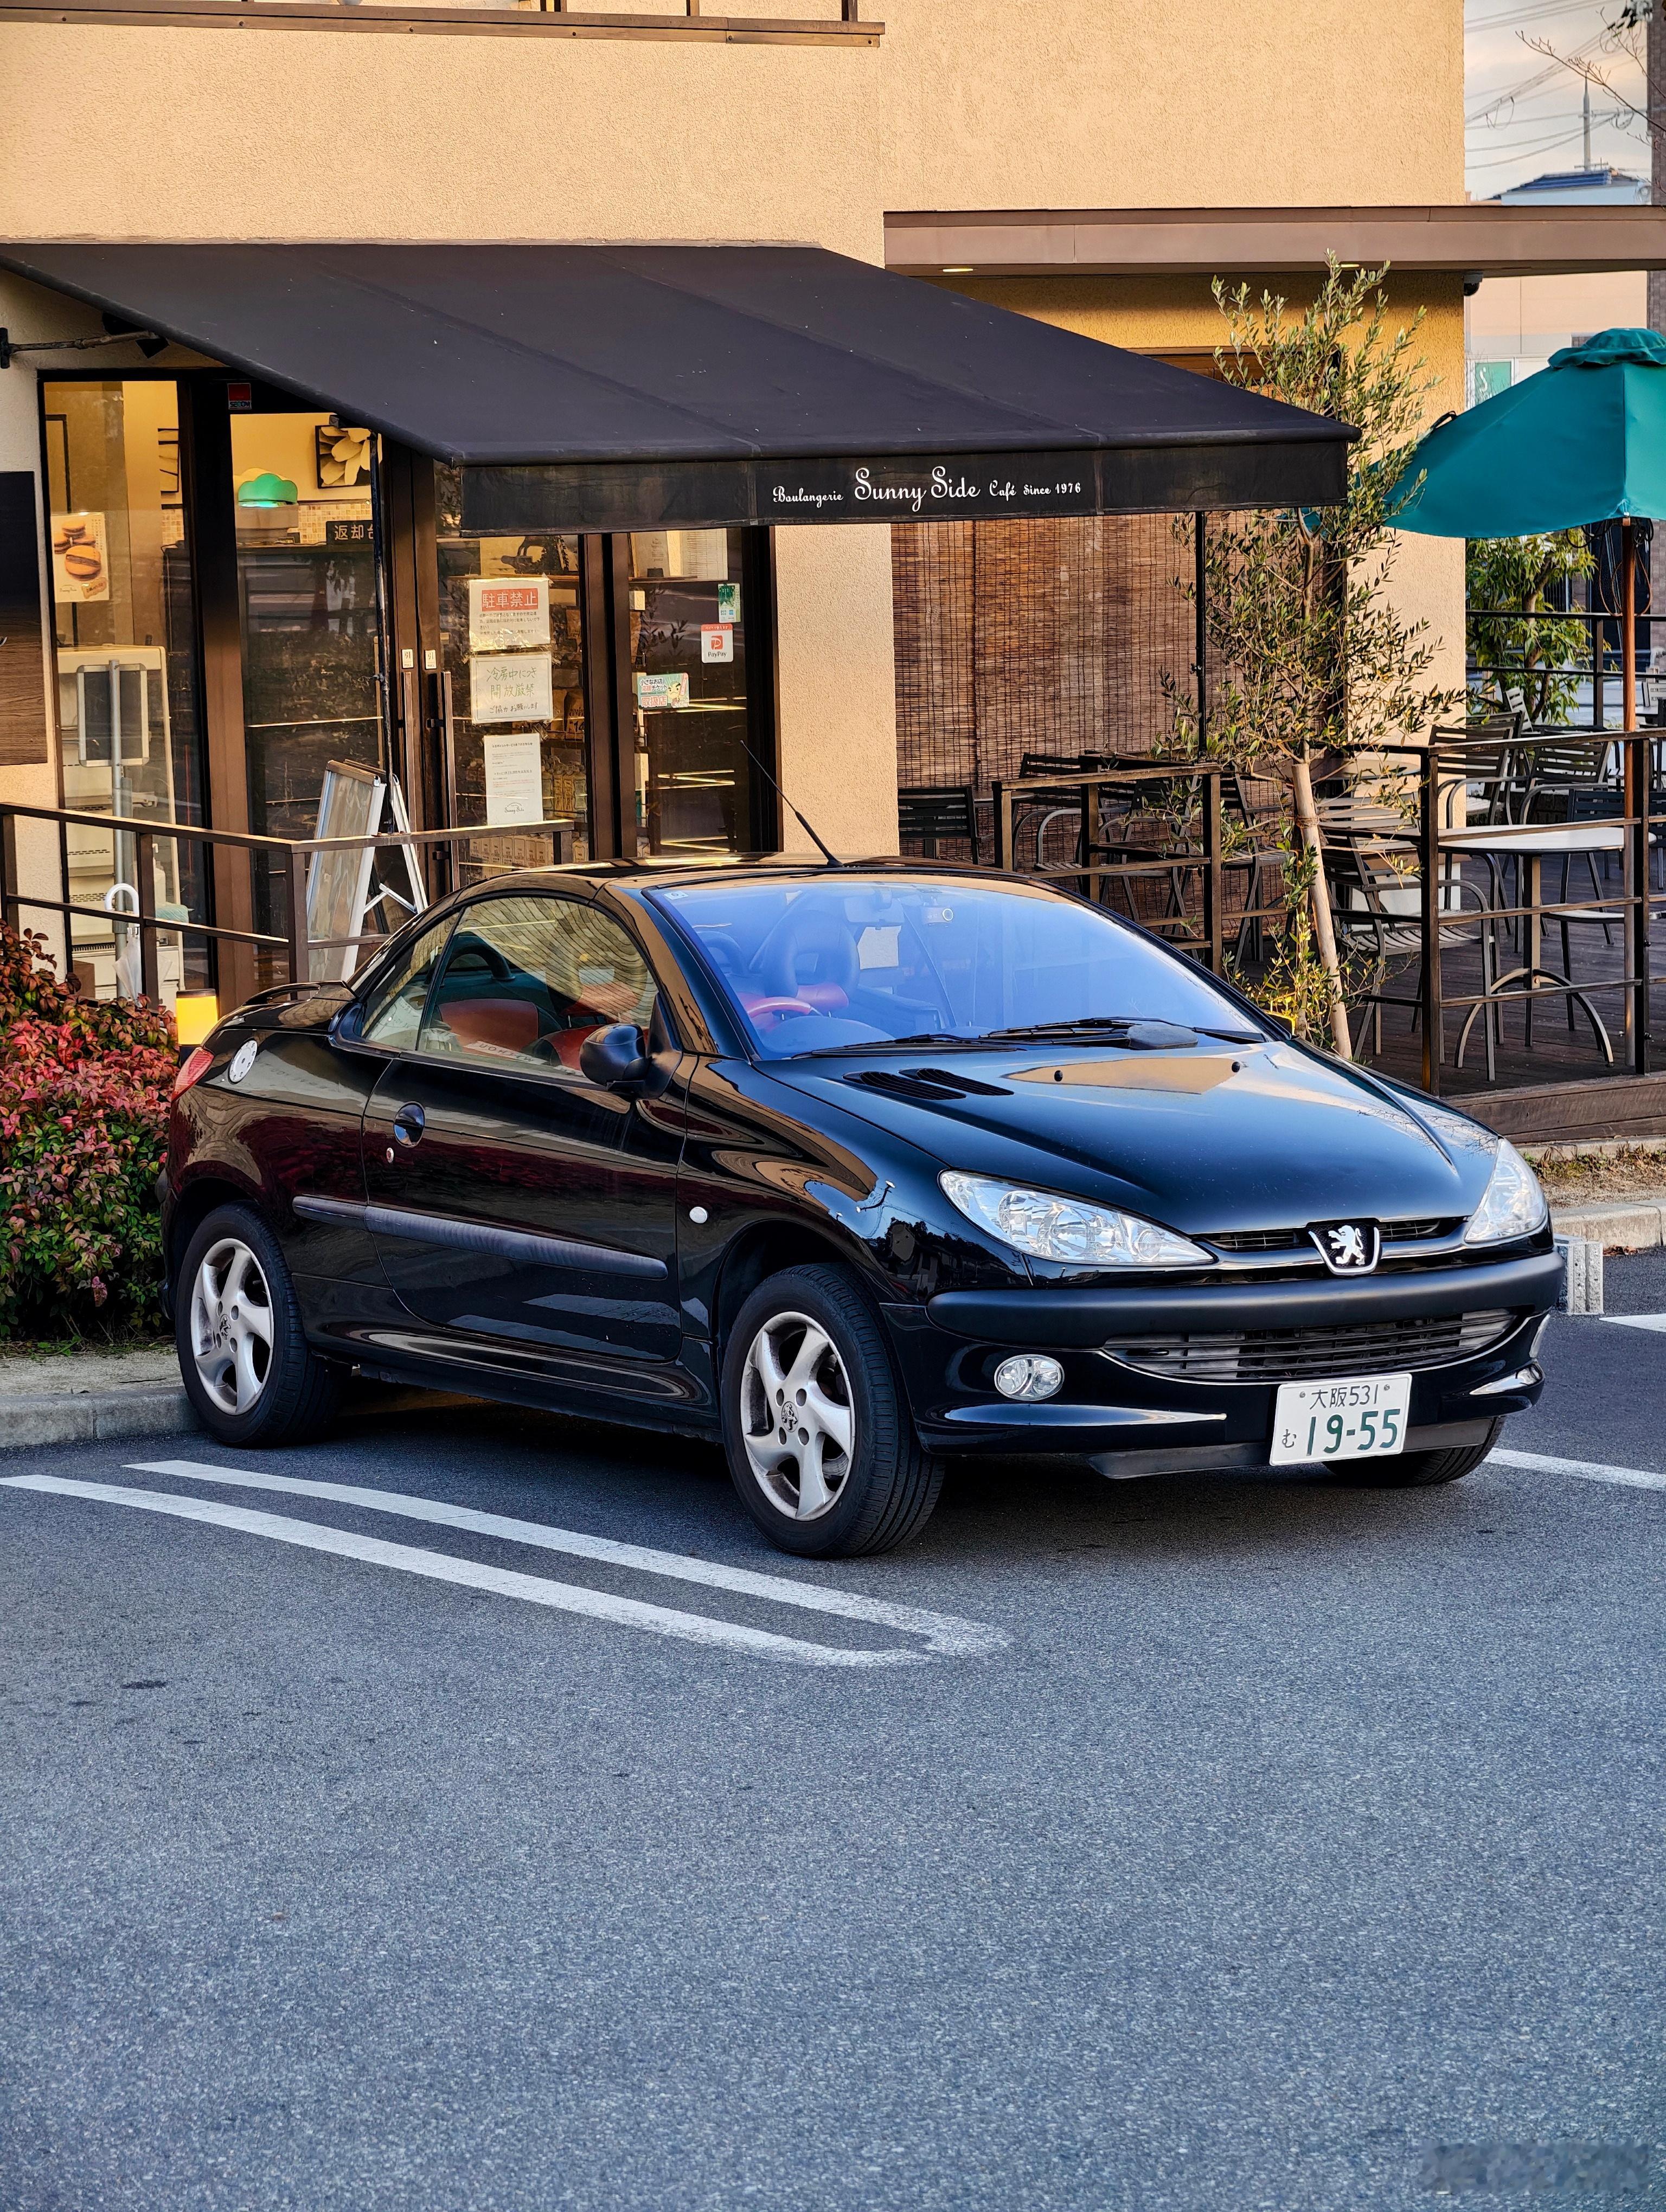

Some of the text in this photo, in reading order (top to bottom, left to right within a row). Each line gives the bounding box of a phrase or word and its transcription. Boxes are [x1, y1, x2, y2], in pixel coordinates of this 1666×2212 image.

[773, 486, 844, 508] Boulangerie
[855, 467, 927, 512] Sunny
[931, 466, 981, 498] Side
[989, 480, 1017, 501] Café
[1055, 482, 1081, 494] 1976
[482, 591, 538, 608] 駐車禁止
[486, 666, 537, 682] 冷房中につき
[640, 678, 664, 686] 小さなお店
[490, 683, 535, 700] 開放厳禁
[642, 697, 667, 706] 取扱店
[1309, 1384, 1379, 1410] 大阪531
[1282, 1409, 1400, 1456] む 19-55
